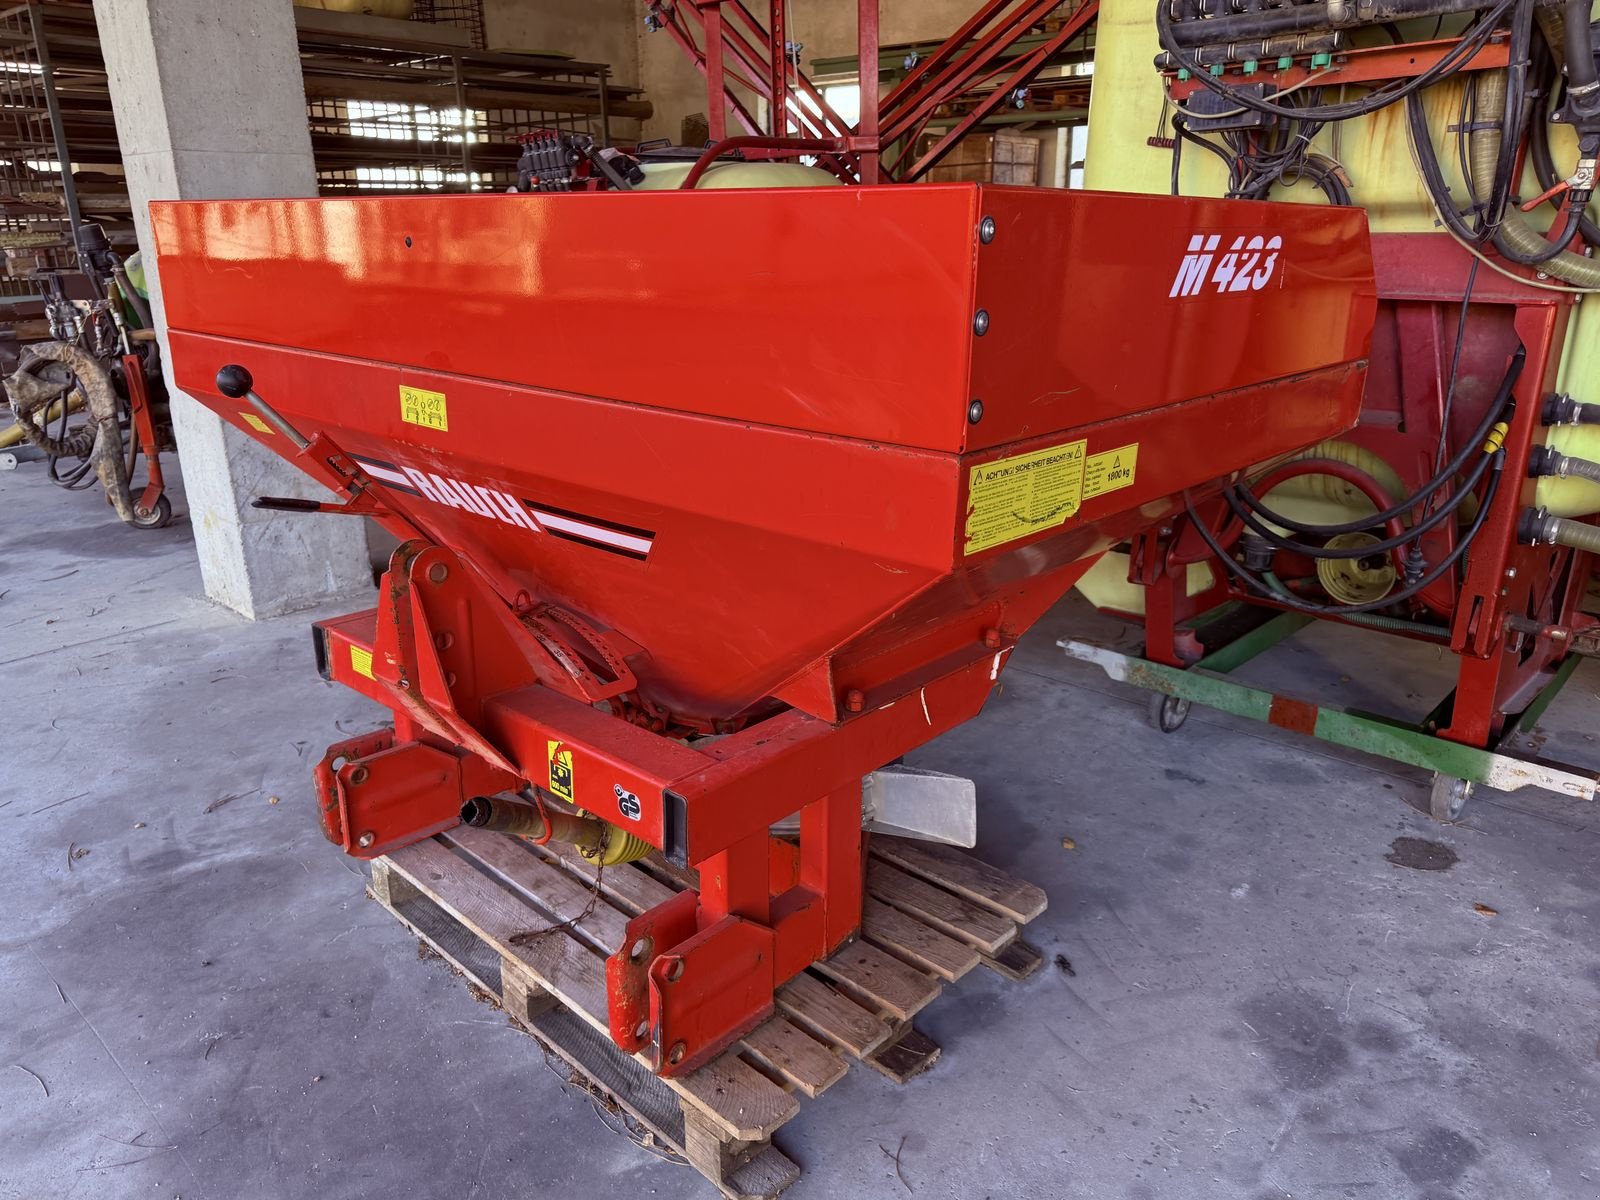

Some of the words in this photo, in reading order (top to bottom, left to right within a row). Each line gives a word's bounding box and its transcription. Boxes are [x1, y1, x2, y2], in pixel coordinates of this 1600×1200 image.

[1169, 235, 1221, 297] M
[1212, 235, 1282, 293] 423
[1123, 468, 1130, 478] kg
[400, 465, 541, 532] RAUCH
[619, 794, 640, 816] GS
